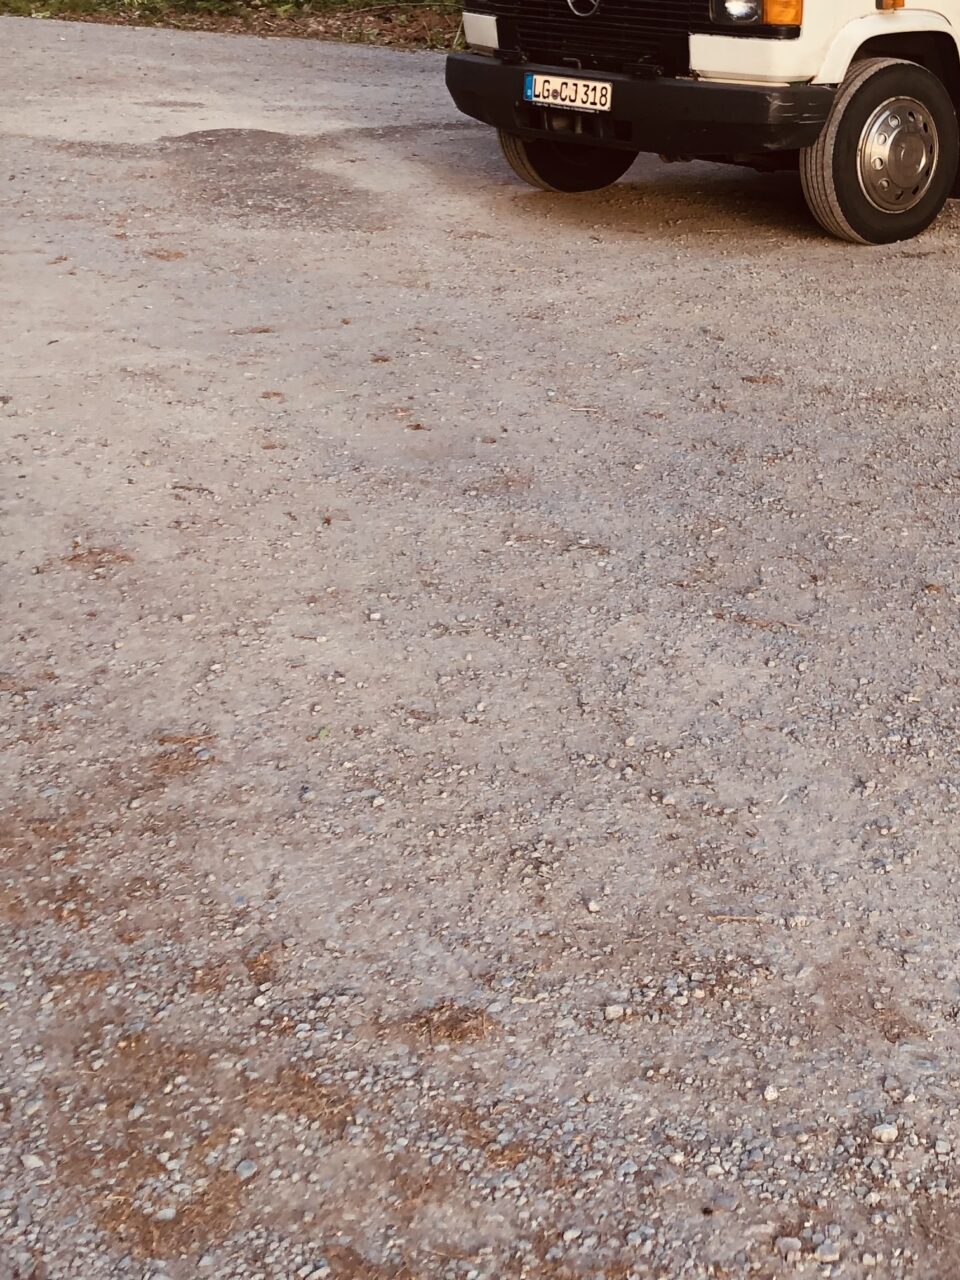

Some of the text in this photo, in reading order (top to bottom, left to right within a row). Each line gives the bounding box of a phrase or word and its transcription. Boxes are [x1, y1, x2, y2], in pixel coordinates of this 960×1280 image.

[534, 78, 608, 107] LG CJ 318
